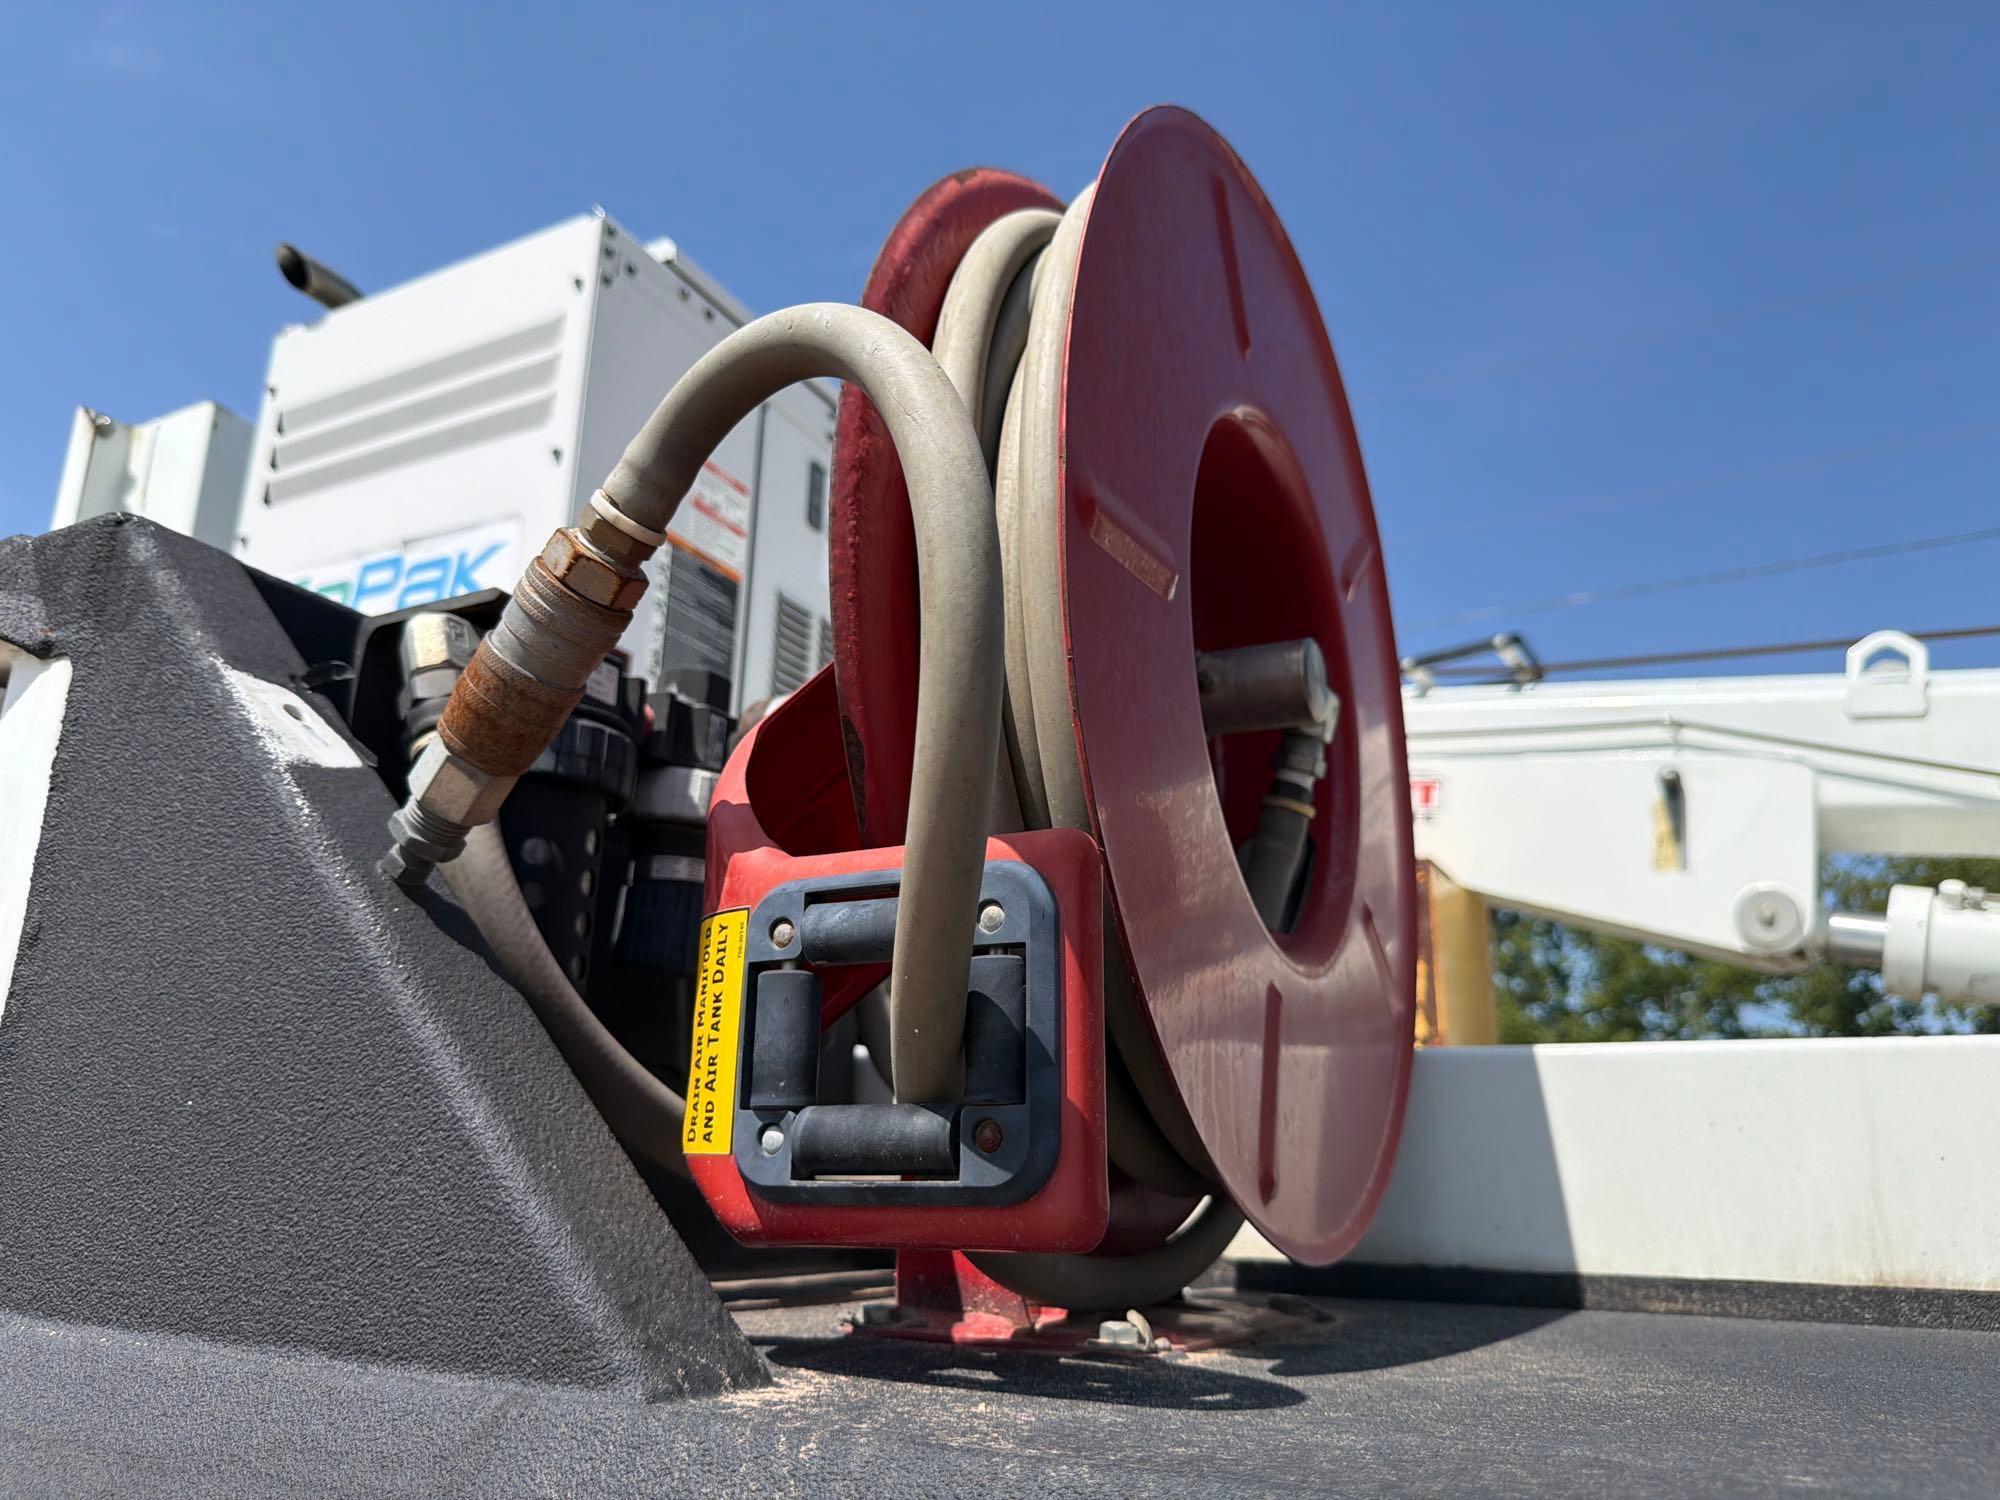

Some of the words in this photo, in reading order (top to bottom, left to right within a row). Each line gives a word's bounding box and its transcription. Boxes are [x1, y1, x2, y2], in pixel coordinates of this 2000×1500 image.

[696, 927, 712, 1028] MANIFOLD
[713, 923, 729, 983] DAILY
[707, 991, 724, 1046] TANK
[694, 1035, 704, 1071] AIR
[704, 1054, 719, 1092] AIR
[687, 1077, 701, 1143] DRAIN
[703, 1100, 715, 1143] AND
